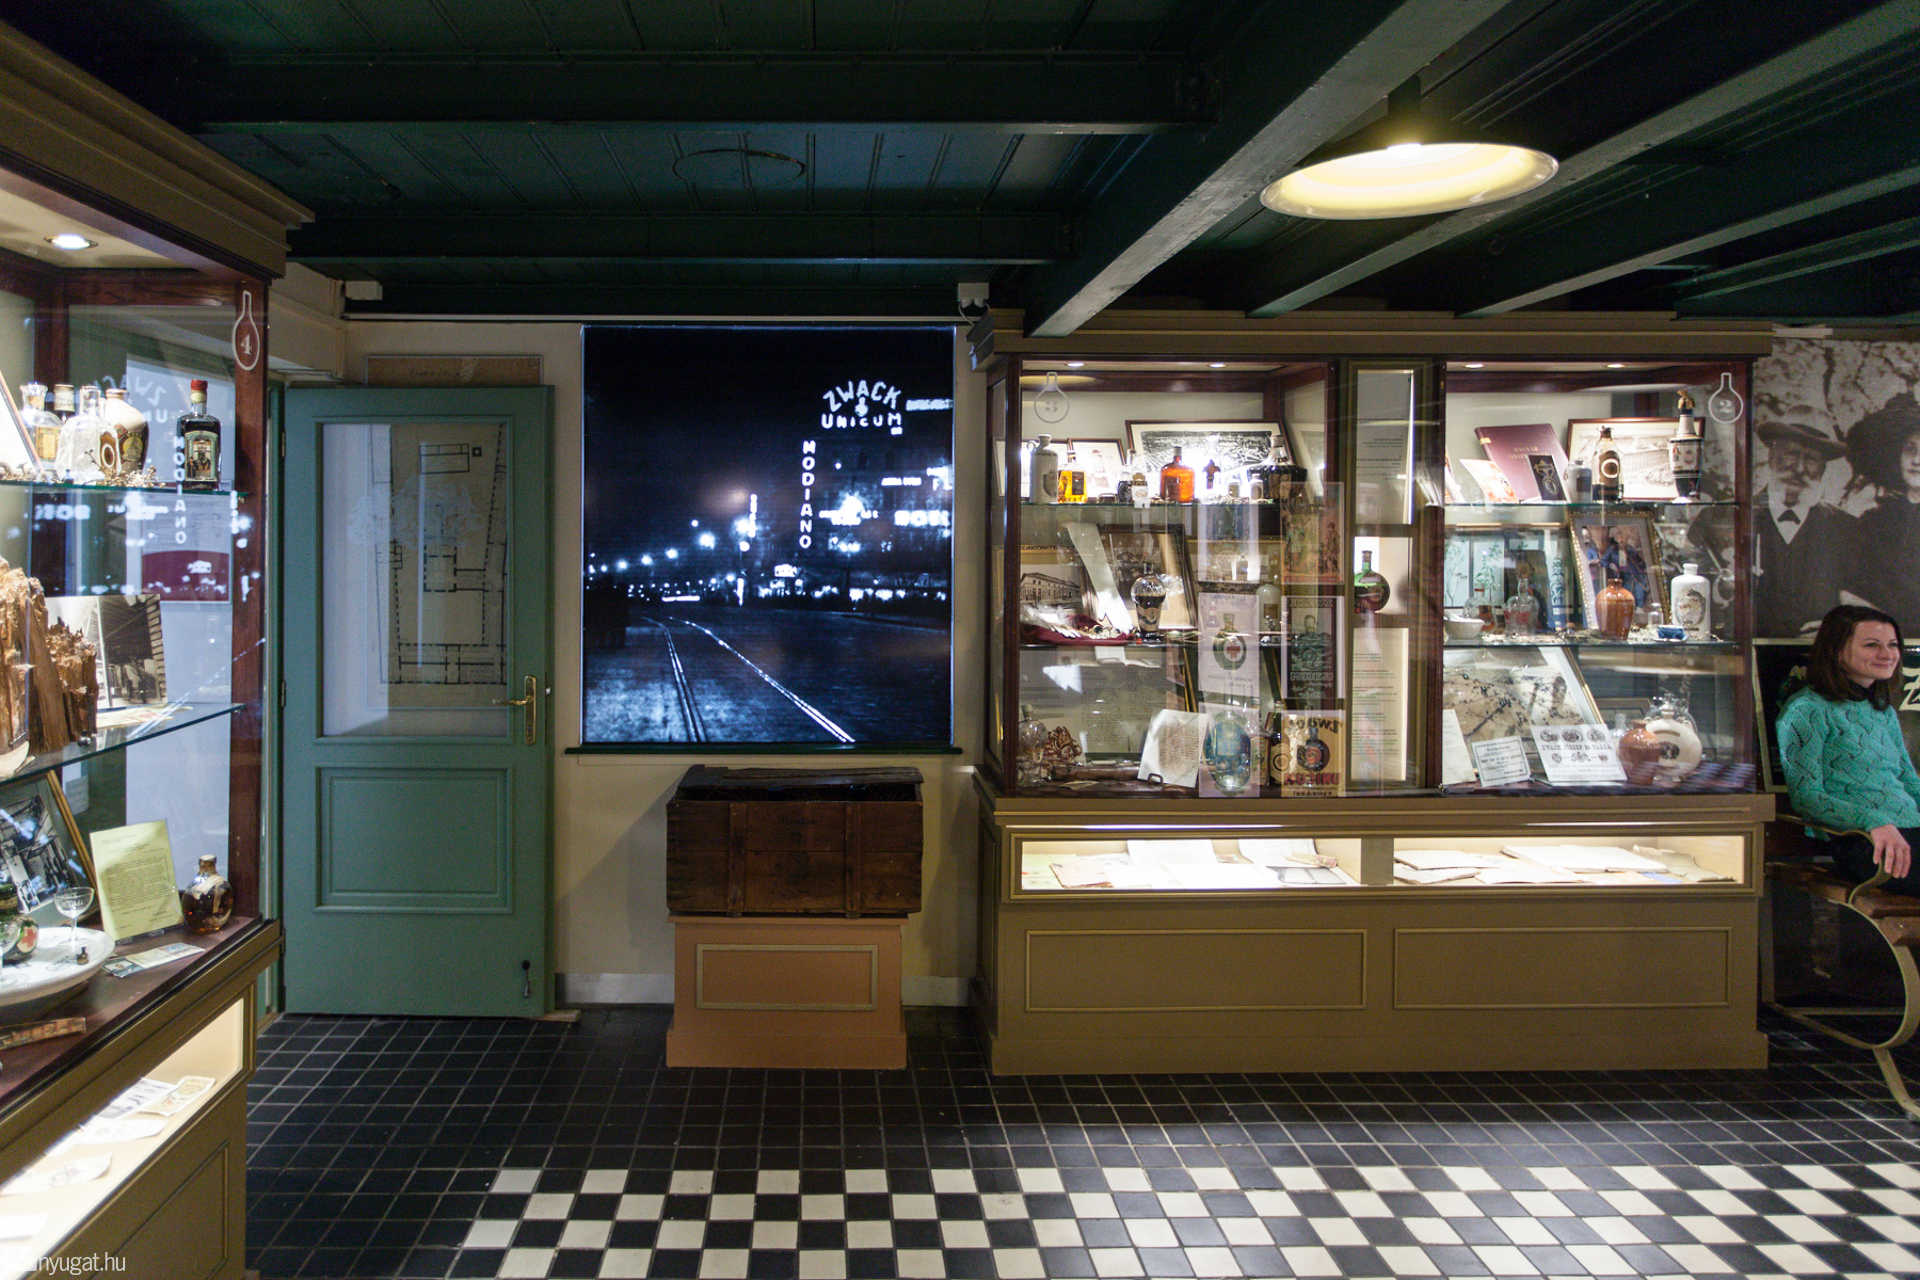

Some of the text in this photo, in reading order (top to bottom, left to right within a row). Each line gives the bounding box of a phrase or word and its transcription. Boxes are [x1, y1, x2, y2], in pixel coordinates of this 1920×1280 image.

[822, 379, 902, 413] ZWACK
[820, 411, 903, 429] UNICUM
[799, 439, 817, 549] MODIANO
